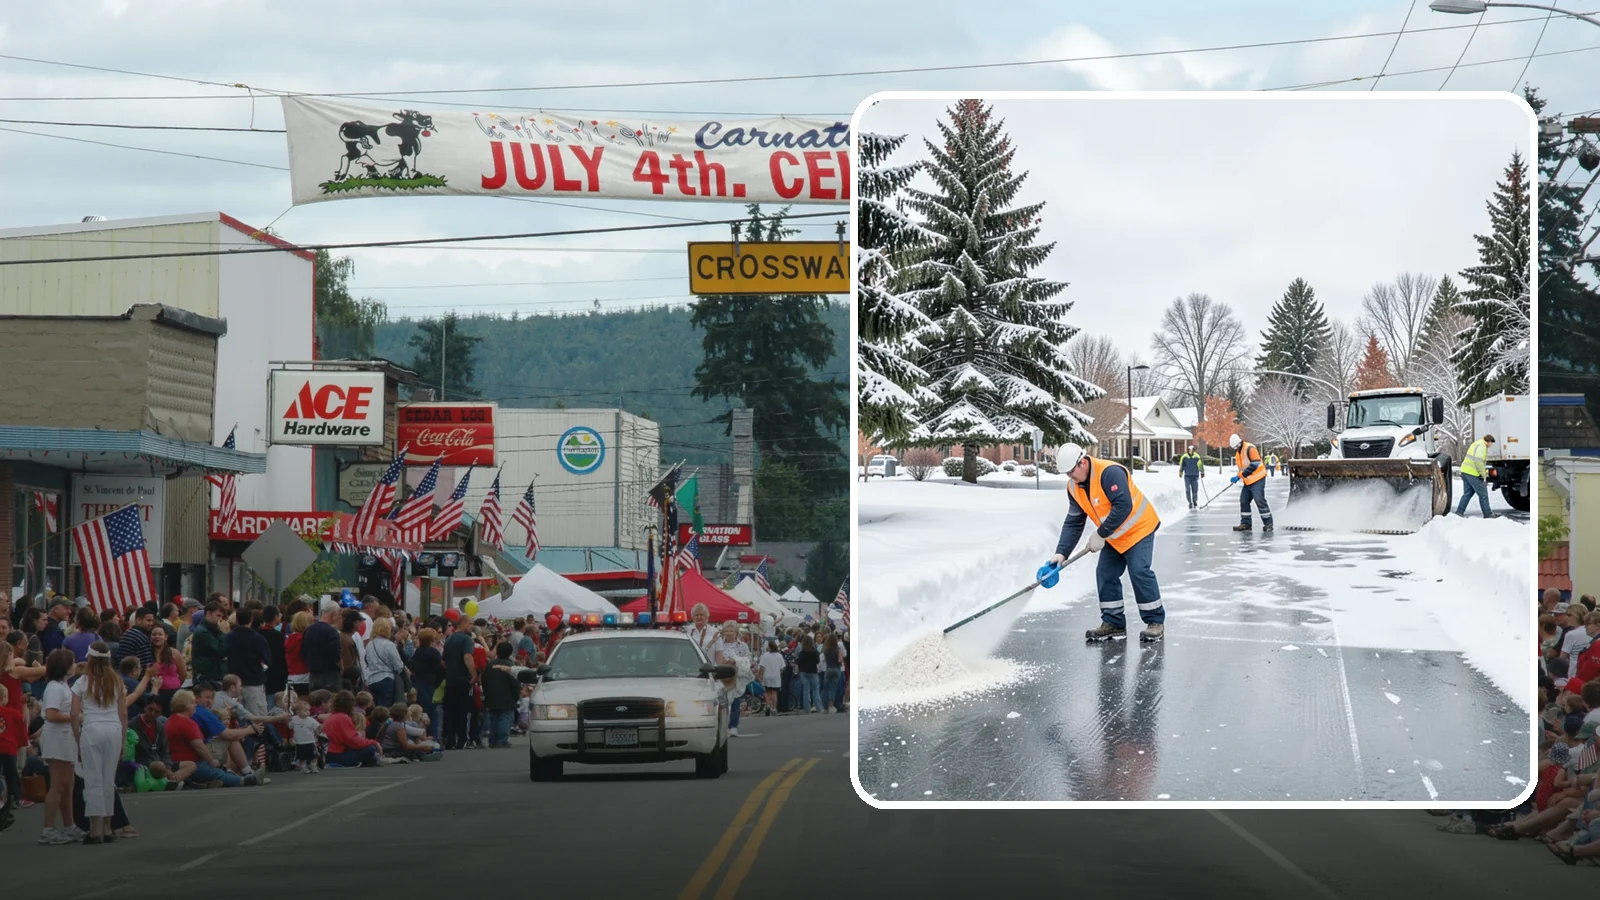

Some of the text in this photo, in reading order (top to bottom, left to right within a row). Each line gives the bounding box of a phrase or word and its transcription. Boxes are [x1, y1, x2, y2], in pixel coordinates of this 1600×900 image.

[695, 121, 850, 149] Carnat
[481, 141, 604, 192] JULY
[632, 149, 746, 197] 4th.
[697, 254, 850, 280] CROSSWA
[282, 380, 373, 420] ACE
[406, 409, 452, 422] CEDAR
[283, 421, 370, 436] Hardware
[416, 428, 476, 447] Coca-Cola
[353, 467, 388, 480] Simpl
[96, 486, 124, 495] Vincent
[126, 486, 136, 494] de
[138, 486, 155, 495] Paul
[212, 516, 331, 536] HARDARE
[688, 526, 741, 535] CRNATION
[699, 535, 730, 543] GLASS
